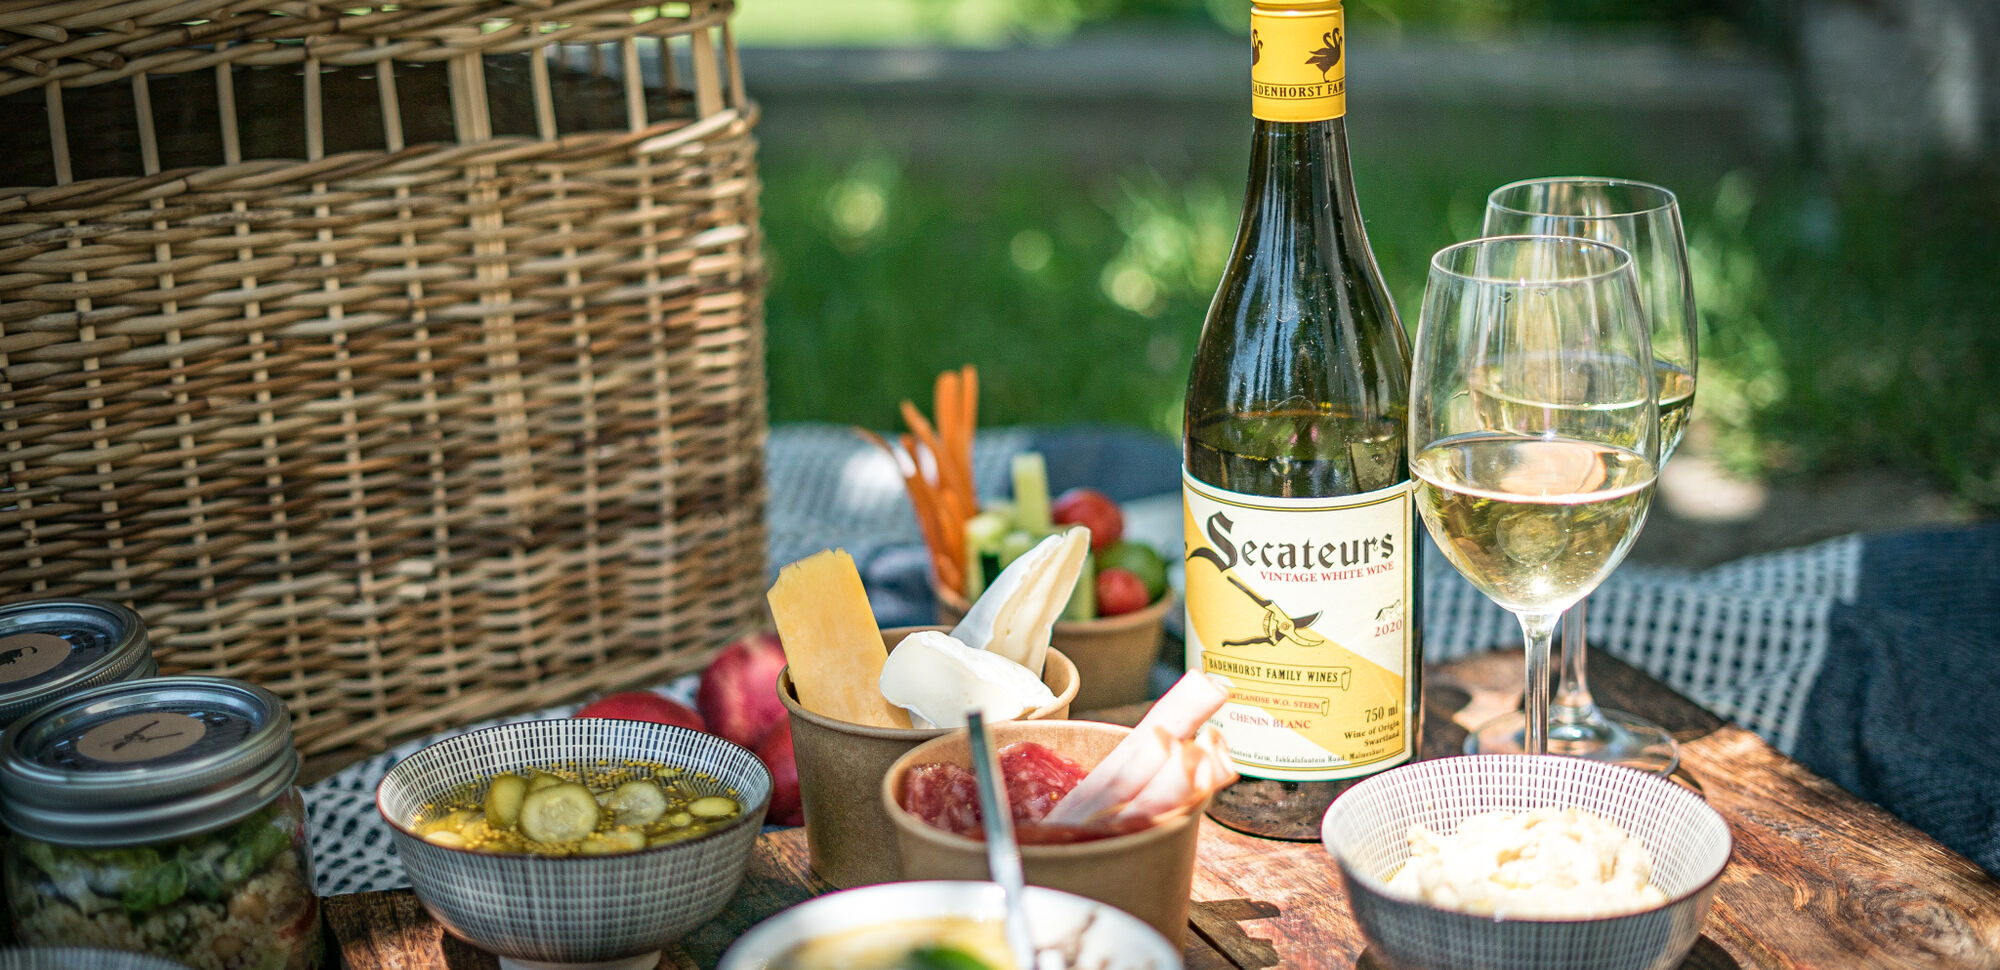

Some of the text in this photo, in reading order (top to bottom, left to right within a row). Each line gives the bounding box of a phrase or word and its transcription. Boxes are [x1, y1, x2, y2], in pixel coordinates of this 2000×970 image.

[1252, 83, 1322, 97] ADENHORST
[1186, 511, 1394, 572] Secateurs
[1260, 561, 1395, 583] VINTAGE WHITE WINE
[1374, 619, 1402, 637] 2020
[1208, 658, 1339, 683] BADENHORST FAMILY WINES
[1293, 700, 1320, 710] STEEN
[1364, 700, 1398, 723] 750 ml
[1229, 711, 1269, 727] CHENIN
[1272, 719, 1312, 729] BLANC
[1344, 721, 1399, 739] Wine of Origin
[1364, 729, 1400, 746] Swartland
